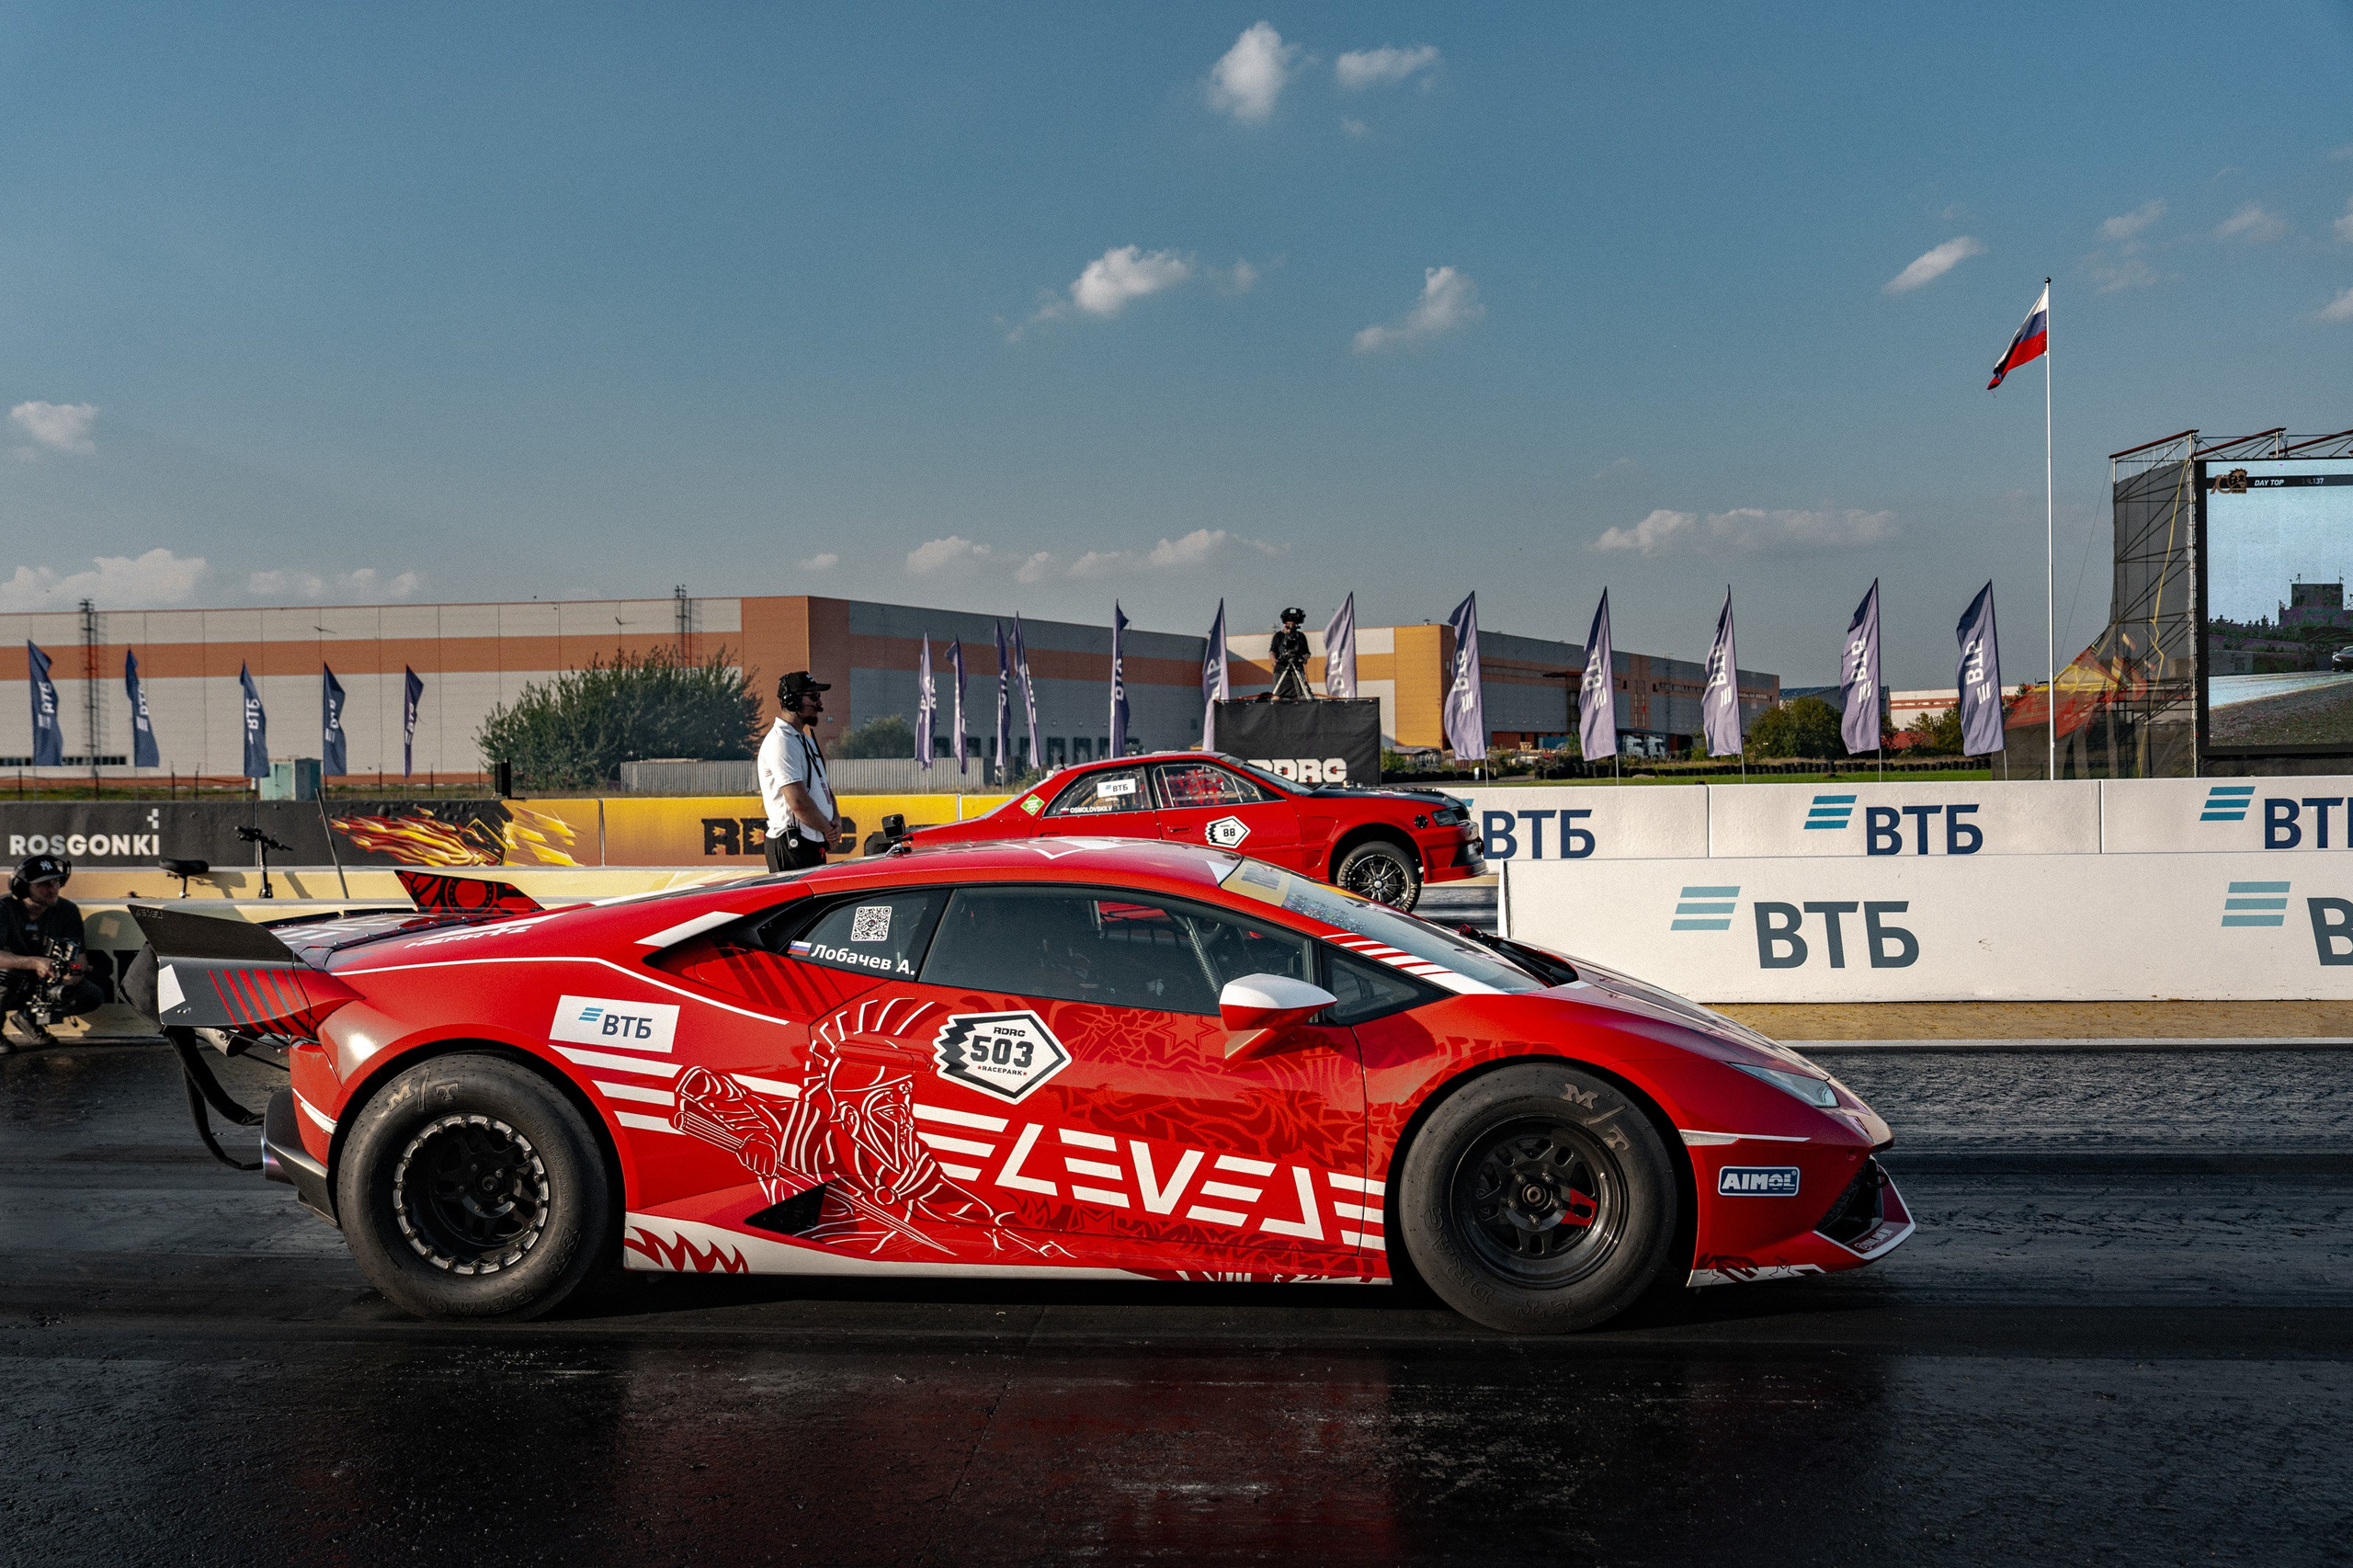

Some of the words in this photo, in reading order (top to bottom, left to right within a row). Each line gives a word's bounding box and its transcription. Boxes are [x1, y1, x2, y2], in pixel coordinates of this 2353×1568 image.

[244, 697, 261, 731] ВТБ
[1112, 784, 1129, 792] ВТБ
[701, 817, 858, 856] RDC
[1222, 828, 1236, 837] 88
[1482, 809, 1597, 859] ВТБ
[1865, 803, 1984, 856] ВТБ
[2265, 797, 2353, 850] ВТ
[9, 834, 161, 857] ROSGONKI
[1754, 901, 1920, 969] ВТБ
[811, 938, 892, 971] Лобачев
[895, 959, 915, 976] А.
[601, 1014, 654, 1040] ВТБ
[993, 1026, 1026, 1038] RDRC
[970, 1035, 1035, 1069] 503
[982, 1066, 1023, 1076] RACEPARK
[1721, 1172, 1796, 1190] AIMOL
